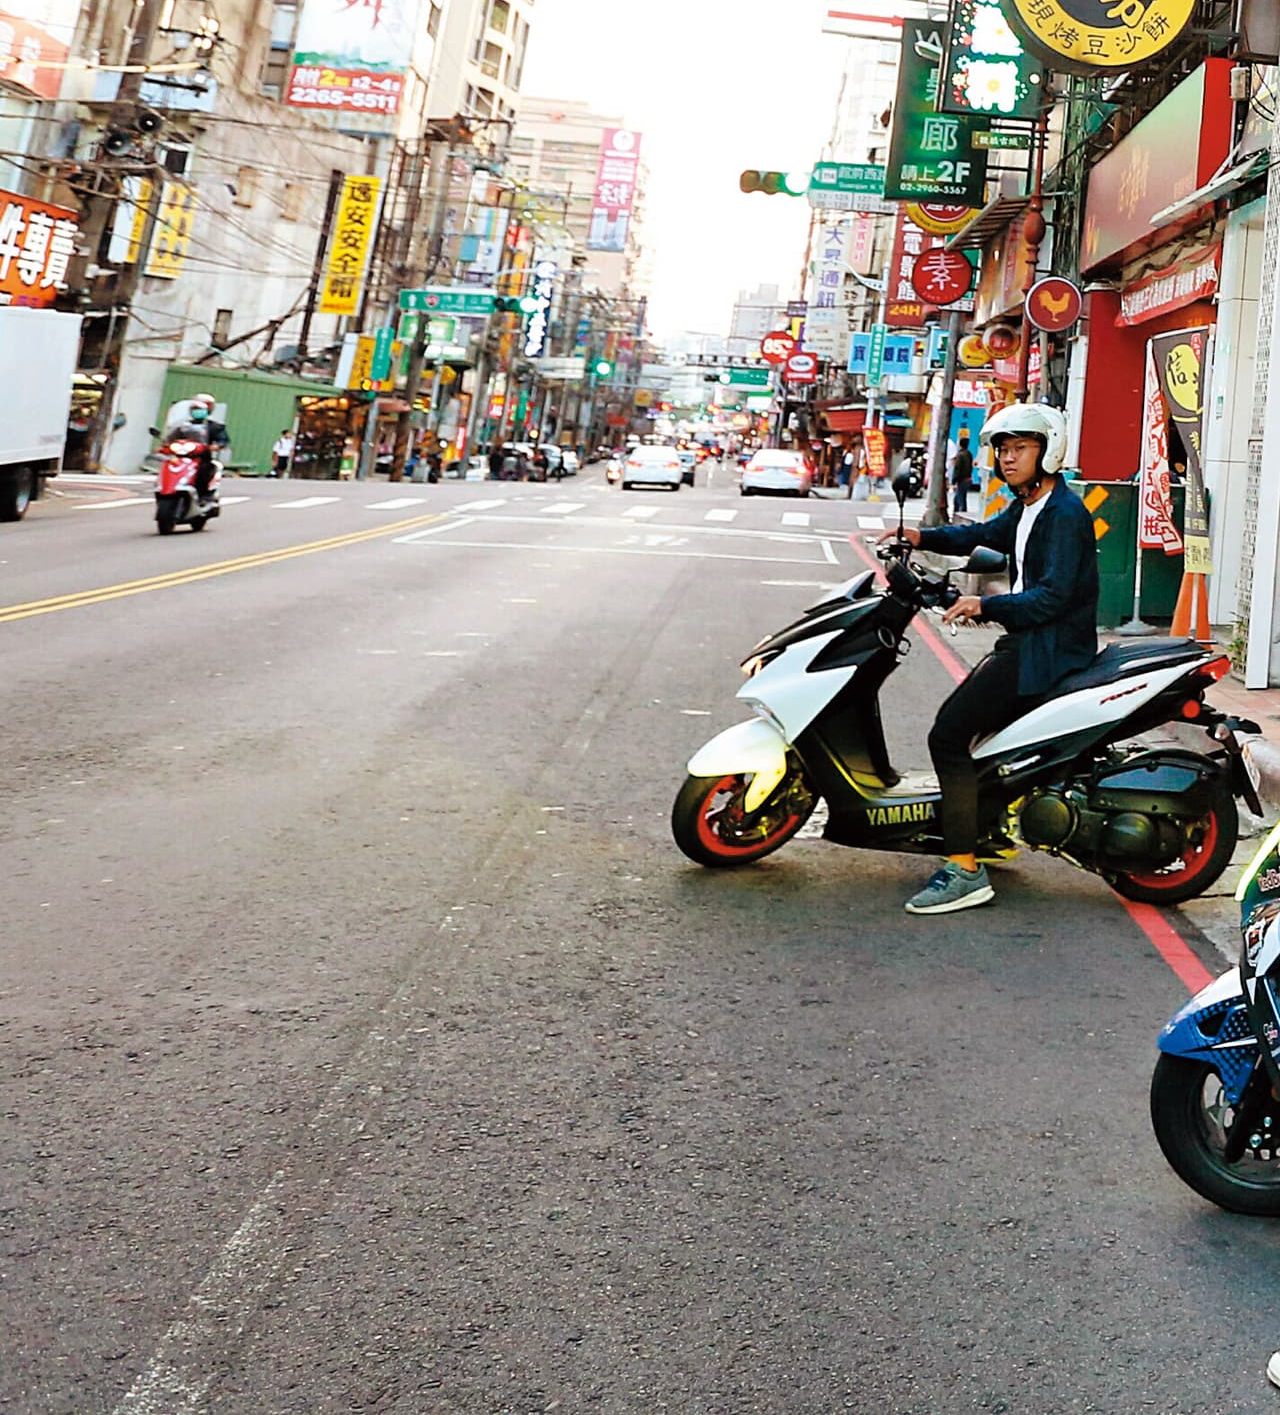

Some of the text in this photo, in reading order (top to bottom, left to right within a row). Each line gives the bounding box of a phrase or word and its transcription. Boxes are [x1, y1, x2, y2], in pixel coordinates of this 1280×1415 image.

[921, 252, 963, 291] 素
[888, 304, 921, 317] 24H
[866, 801, 936, 827] YAMAHA
